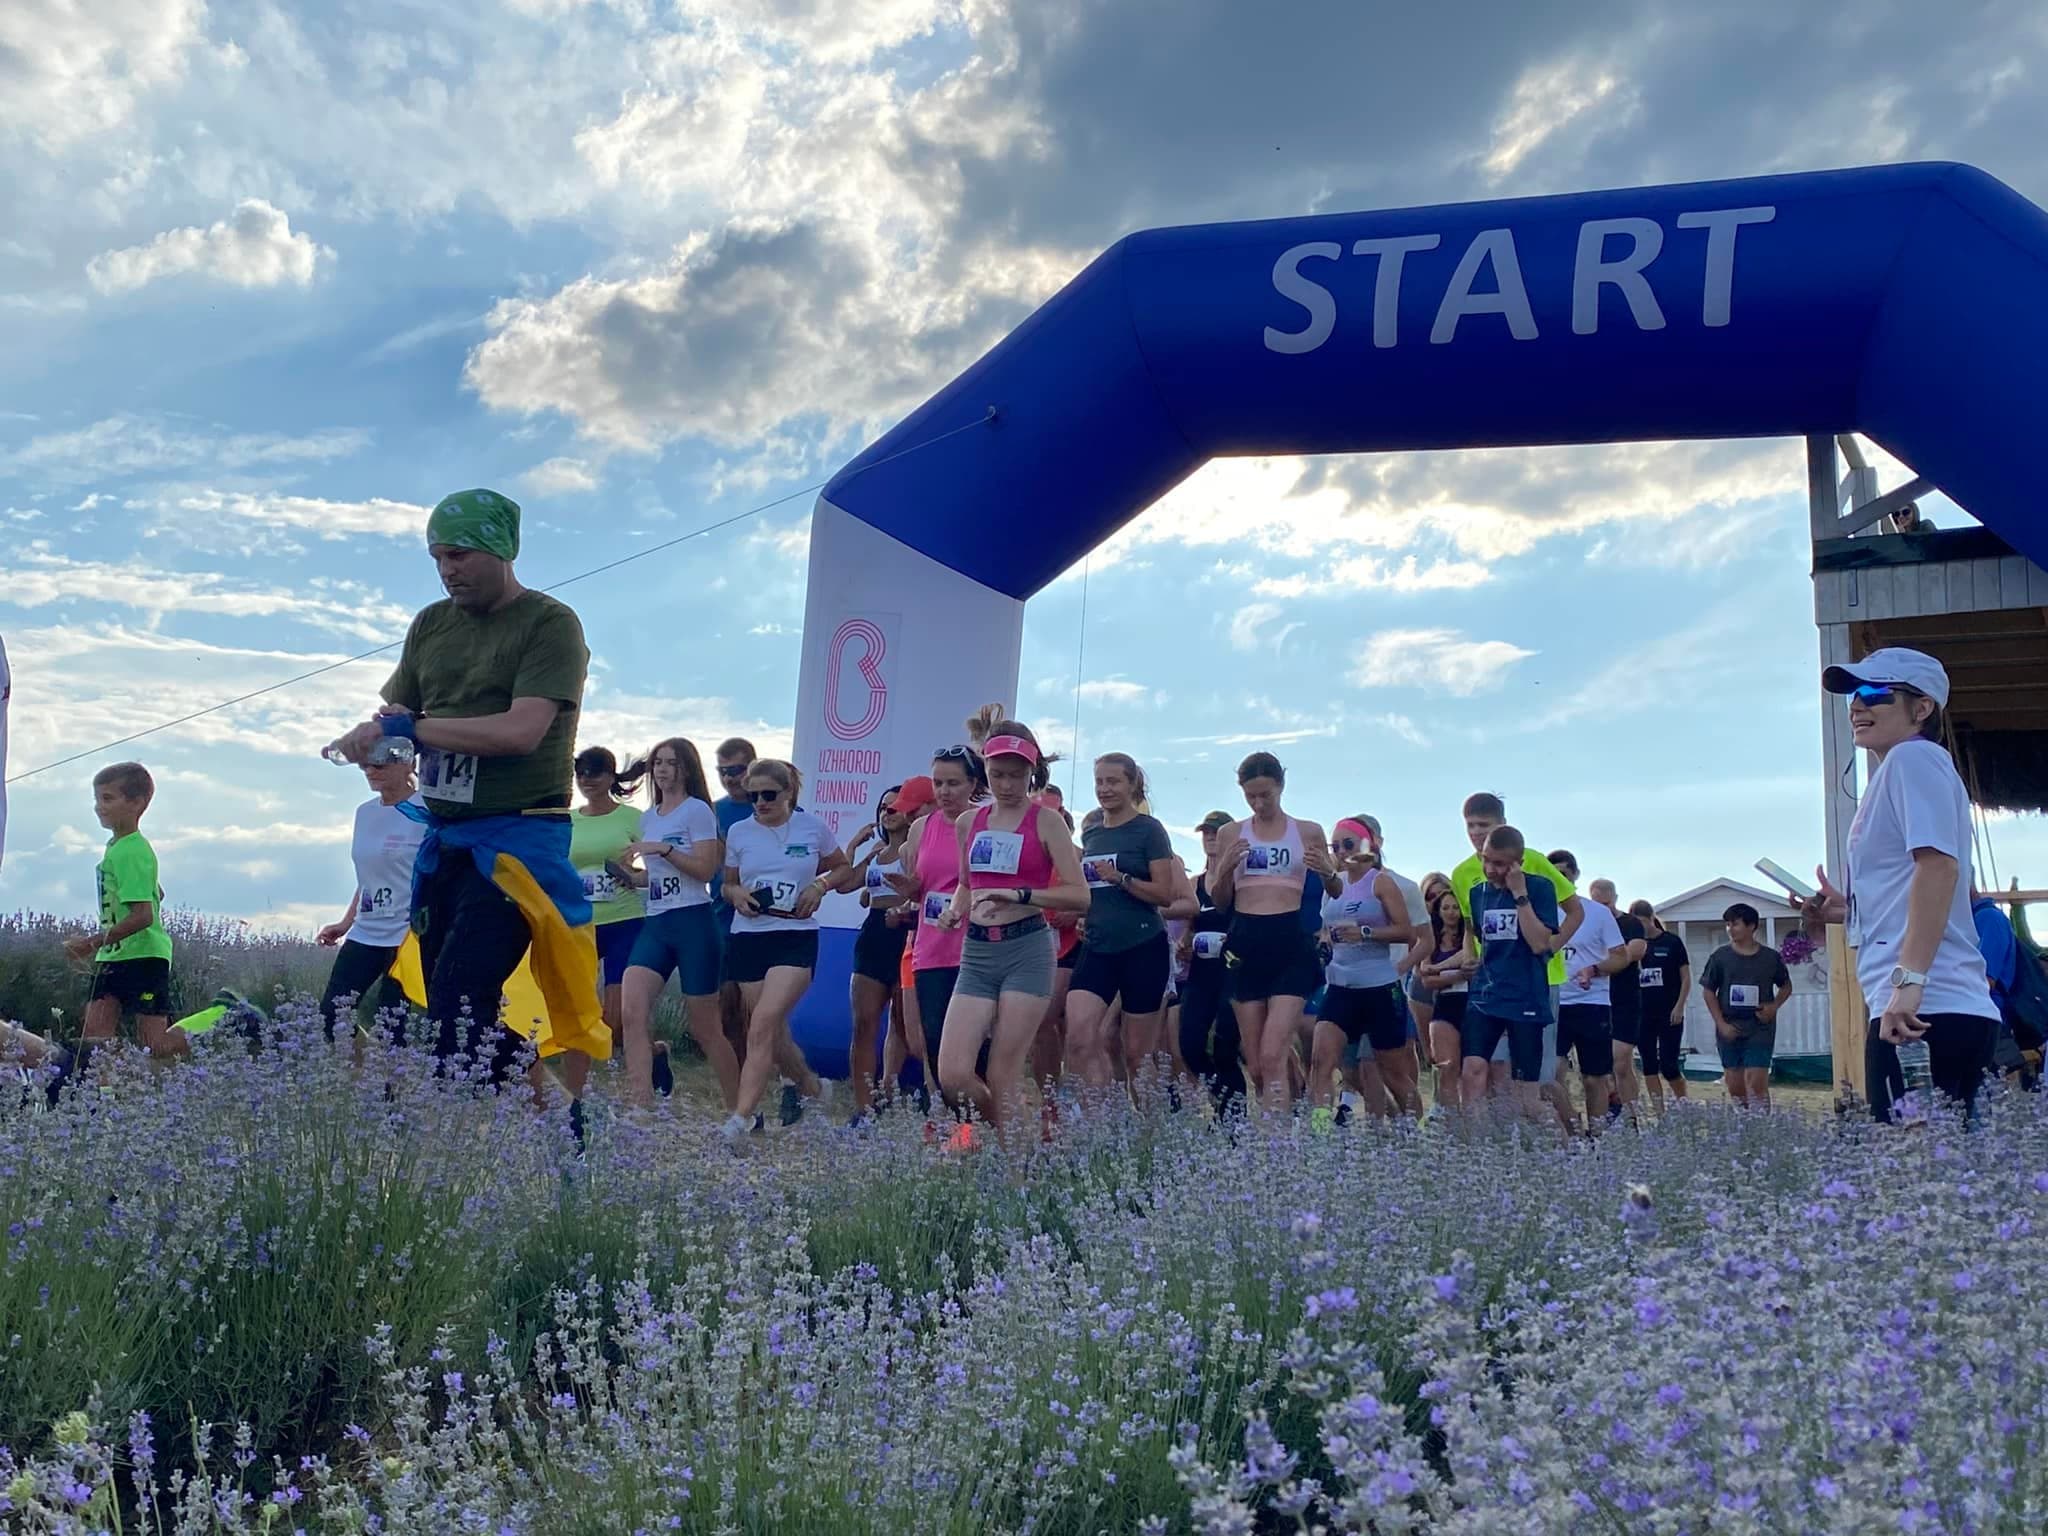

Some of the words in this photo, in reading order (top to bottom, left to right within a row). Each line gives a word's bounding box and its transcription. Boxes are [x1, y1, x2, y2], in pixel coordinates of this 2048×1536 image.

[1264, 205, 1776, 354] START
[444, 752, 474, 788] 14
[818, 748, 881, 774] UZHHOROD
[815, 779, 868, 805] RUNNING
[815, 809, 840, 835] UB
[1269, 847, 1290, 867] 30
[373, 887, 393, 908] 43
[662, 876, 681, 896] 58
[774, 882, 796, 900] 57
[1498, 913, 1517, 931] 37
